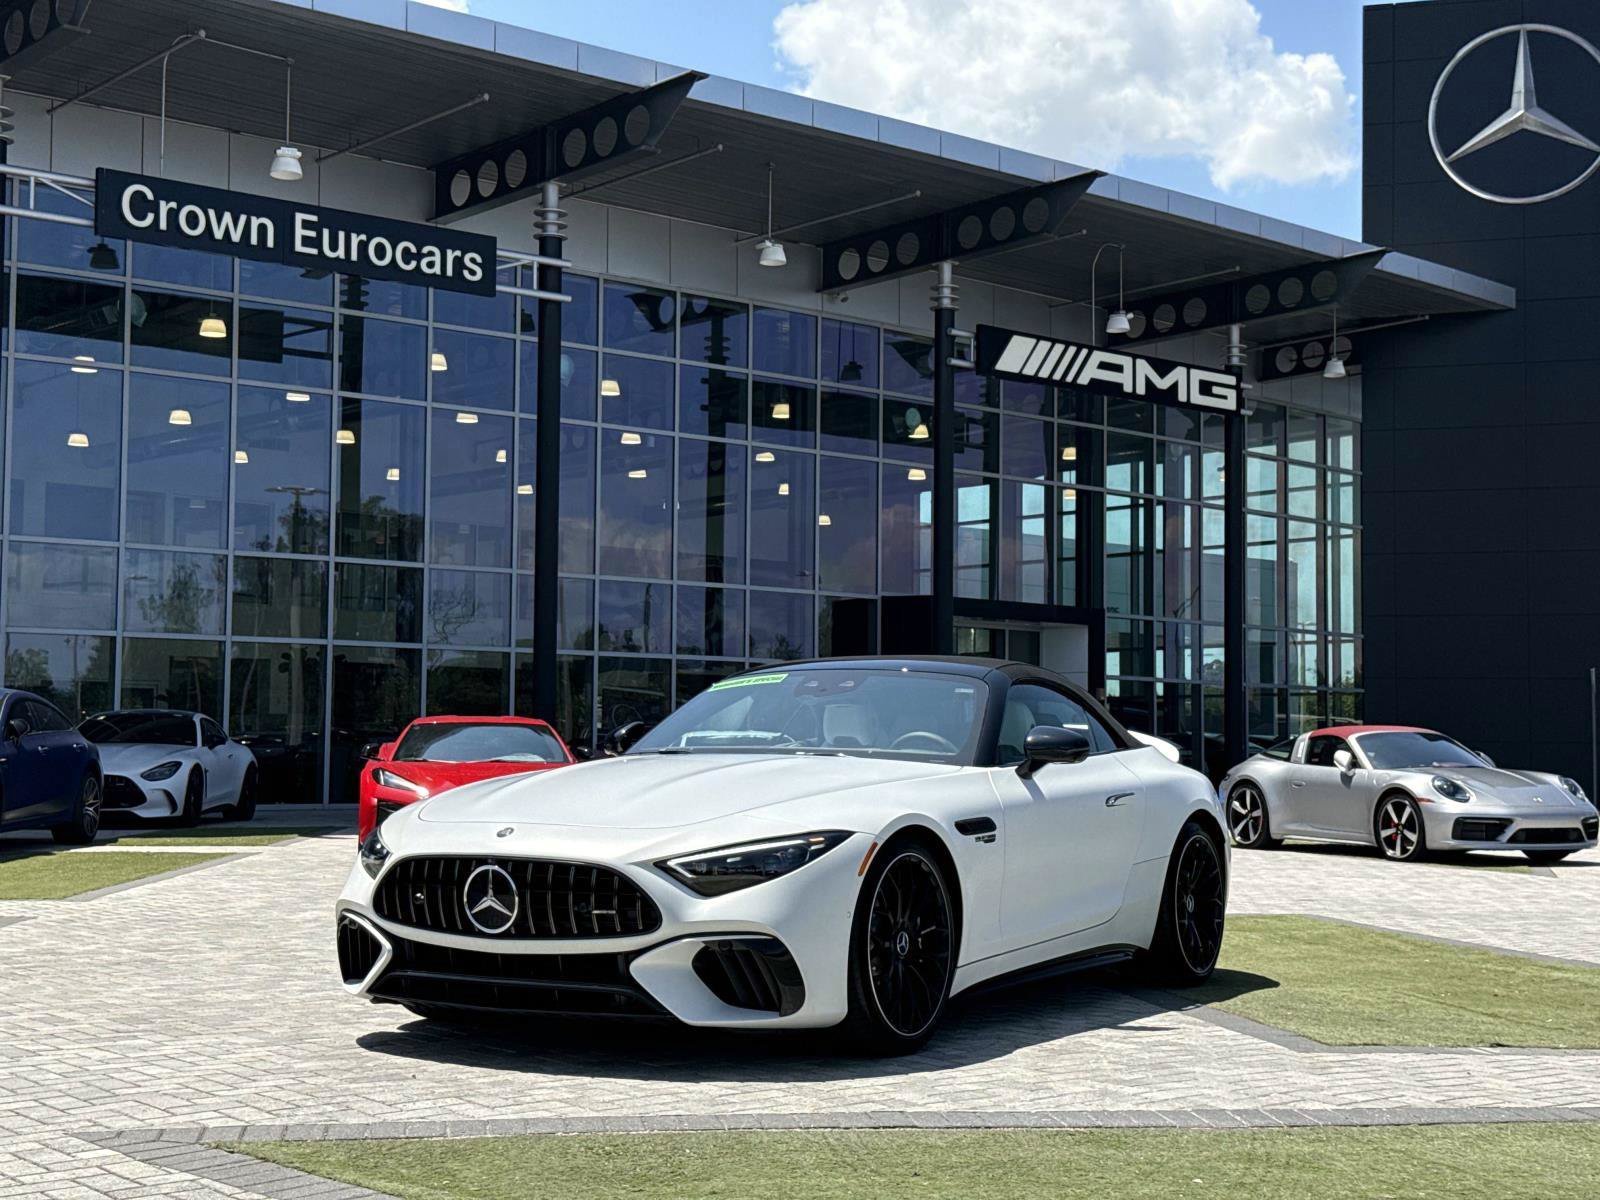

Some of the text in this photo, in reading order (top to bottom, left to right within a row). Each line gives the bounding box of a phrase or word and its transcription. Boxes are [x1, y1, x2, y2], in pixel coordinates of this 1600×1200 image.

[121, 183, 483, 282] Crown Eurocars
[1076, 350, 1237, 411] AMG
